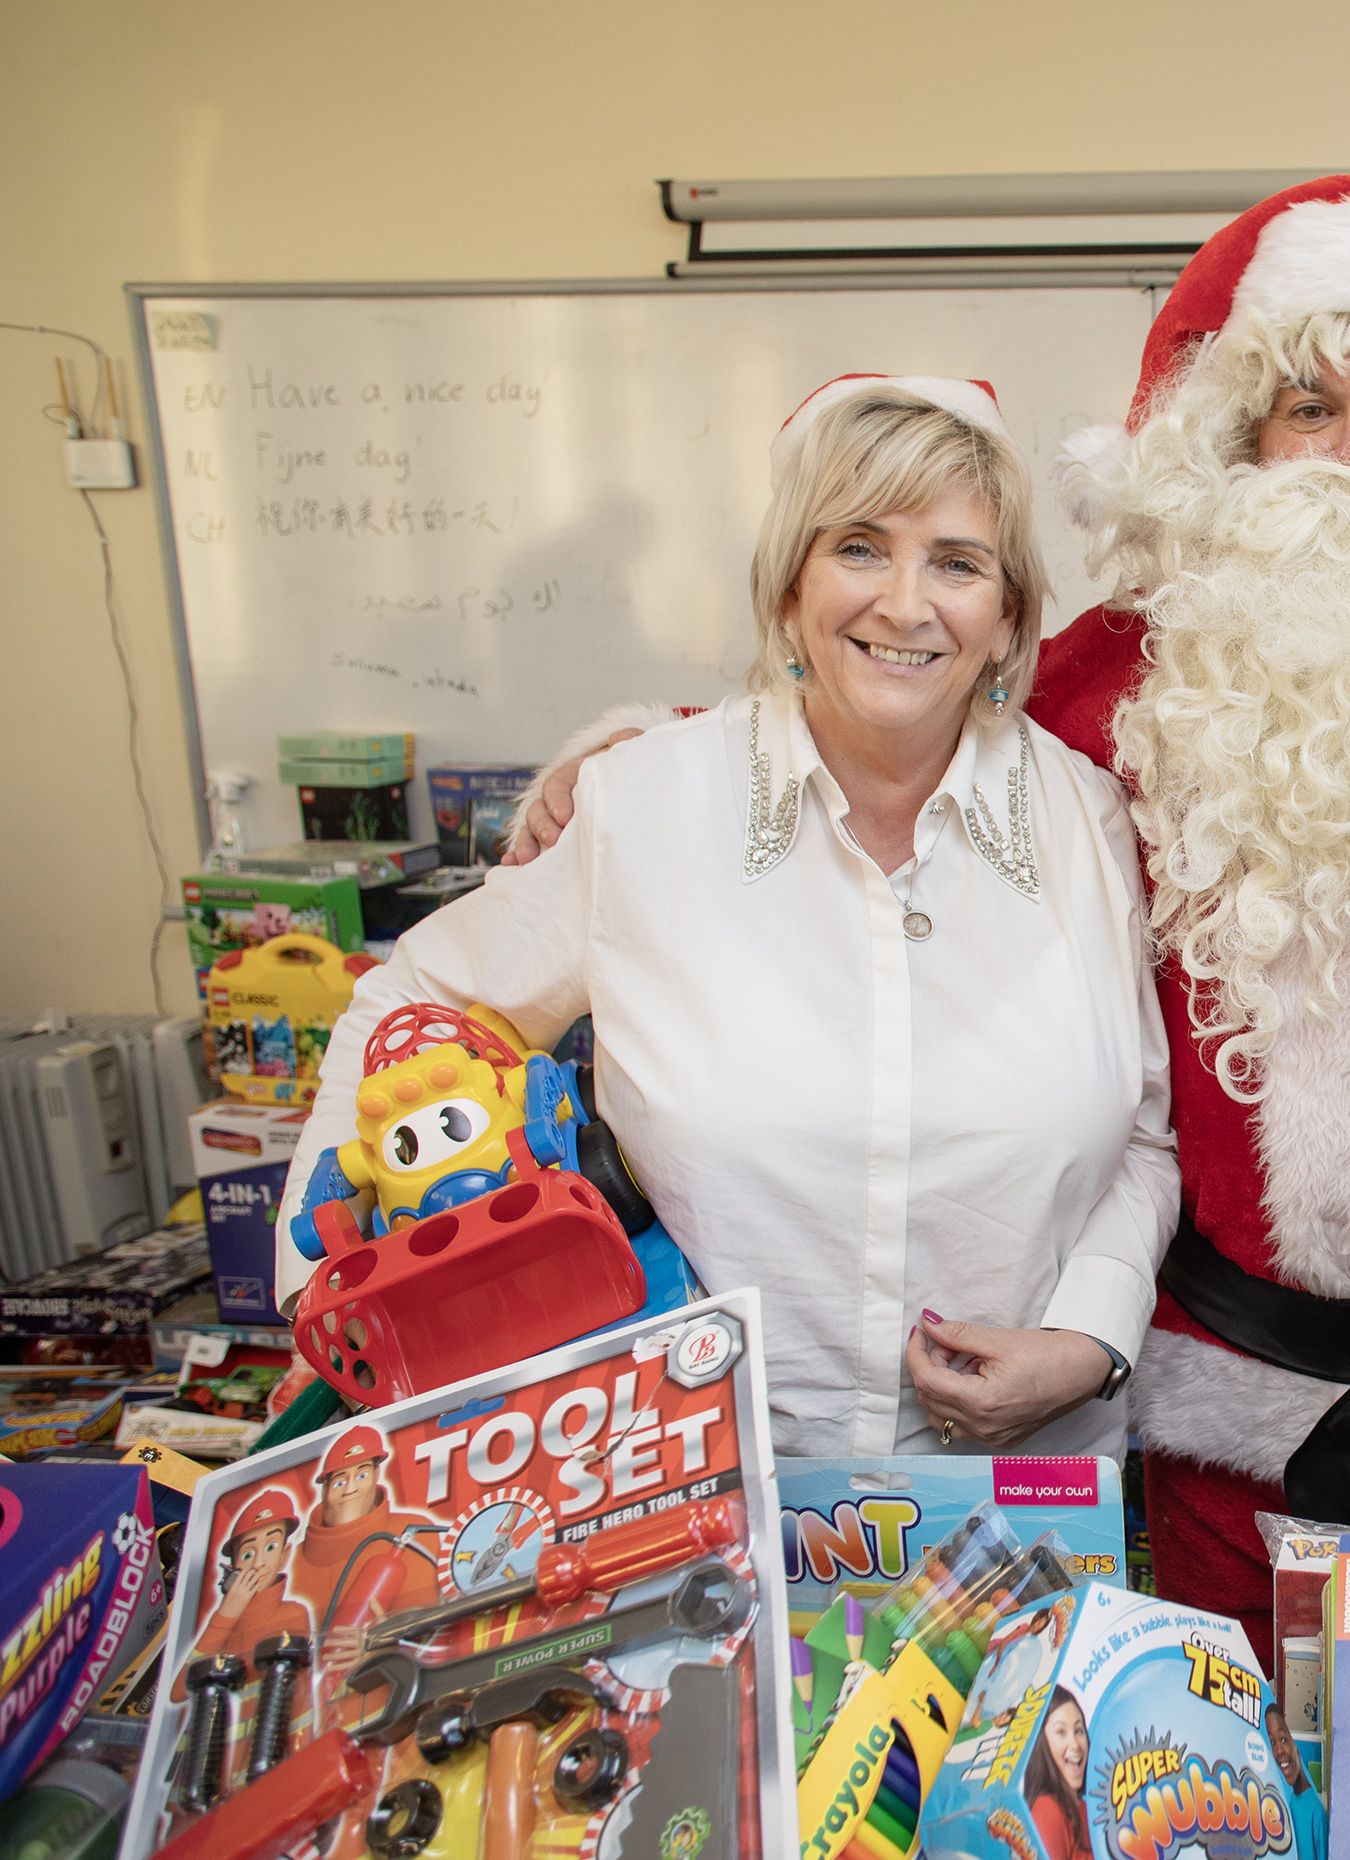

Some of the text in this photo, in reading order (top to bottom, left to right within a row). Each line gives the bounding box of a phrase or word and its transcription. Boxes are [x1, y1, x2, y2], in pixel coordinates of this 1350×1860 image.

[247, 364, 343, 409] Have
[405, 376, 465, 403] nice
[185, 512, 225, 544] CH
[231, 992, 280, 1007] CLASSIC
[208, 1182, 272, 1206] 4-IN-1
[415, 1371, 659, 1503] TOOL
[559, 1406, 721, 1515] SET
[563, 1478, 718, 1543] FIRE HERO TOOL SET
[999, 1484, 1093, 1499] make your own
[61, 1519, 155, 1731] ROADBLOCK
[1190, 1631, 1231, 1663] Over
[503, 1630, 606, 1673] SUPER POWER
[1072, 1646, 1111, 1693] Looks
[1107, 1631, 1132, 1652] like
[1133, 1625, 1142, 1638] a
[1174, 1614, 1197, 1628] plays
[1181, 1640, 1261, 1709] 75 cm
[1222, 1678, 1262, 1730] tall!
[1111, 1749, 1180, 1822] SUPER
